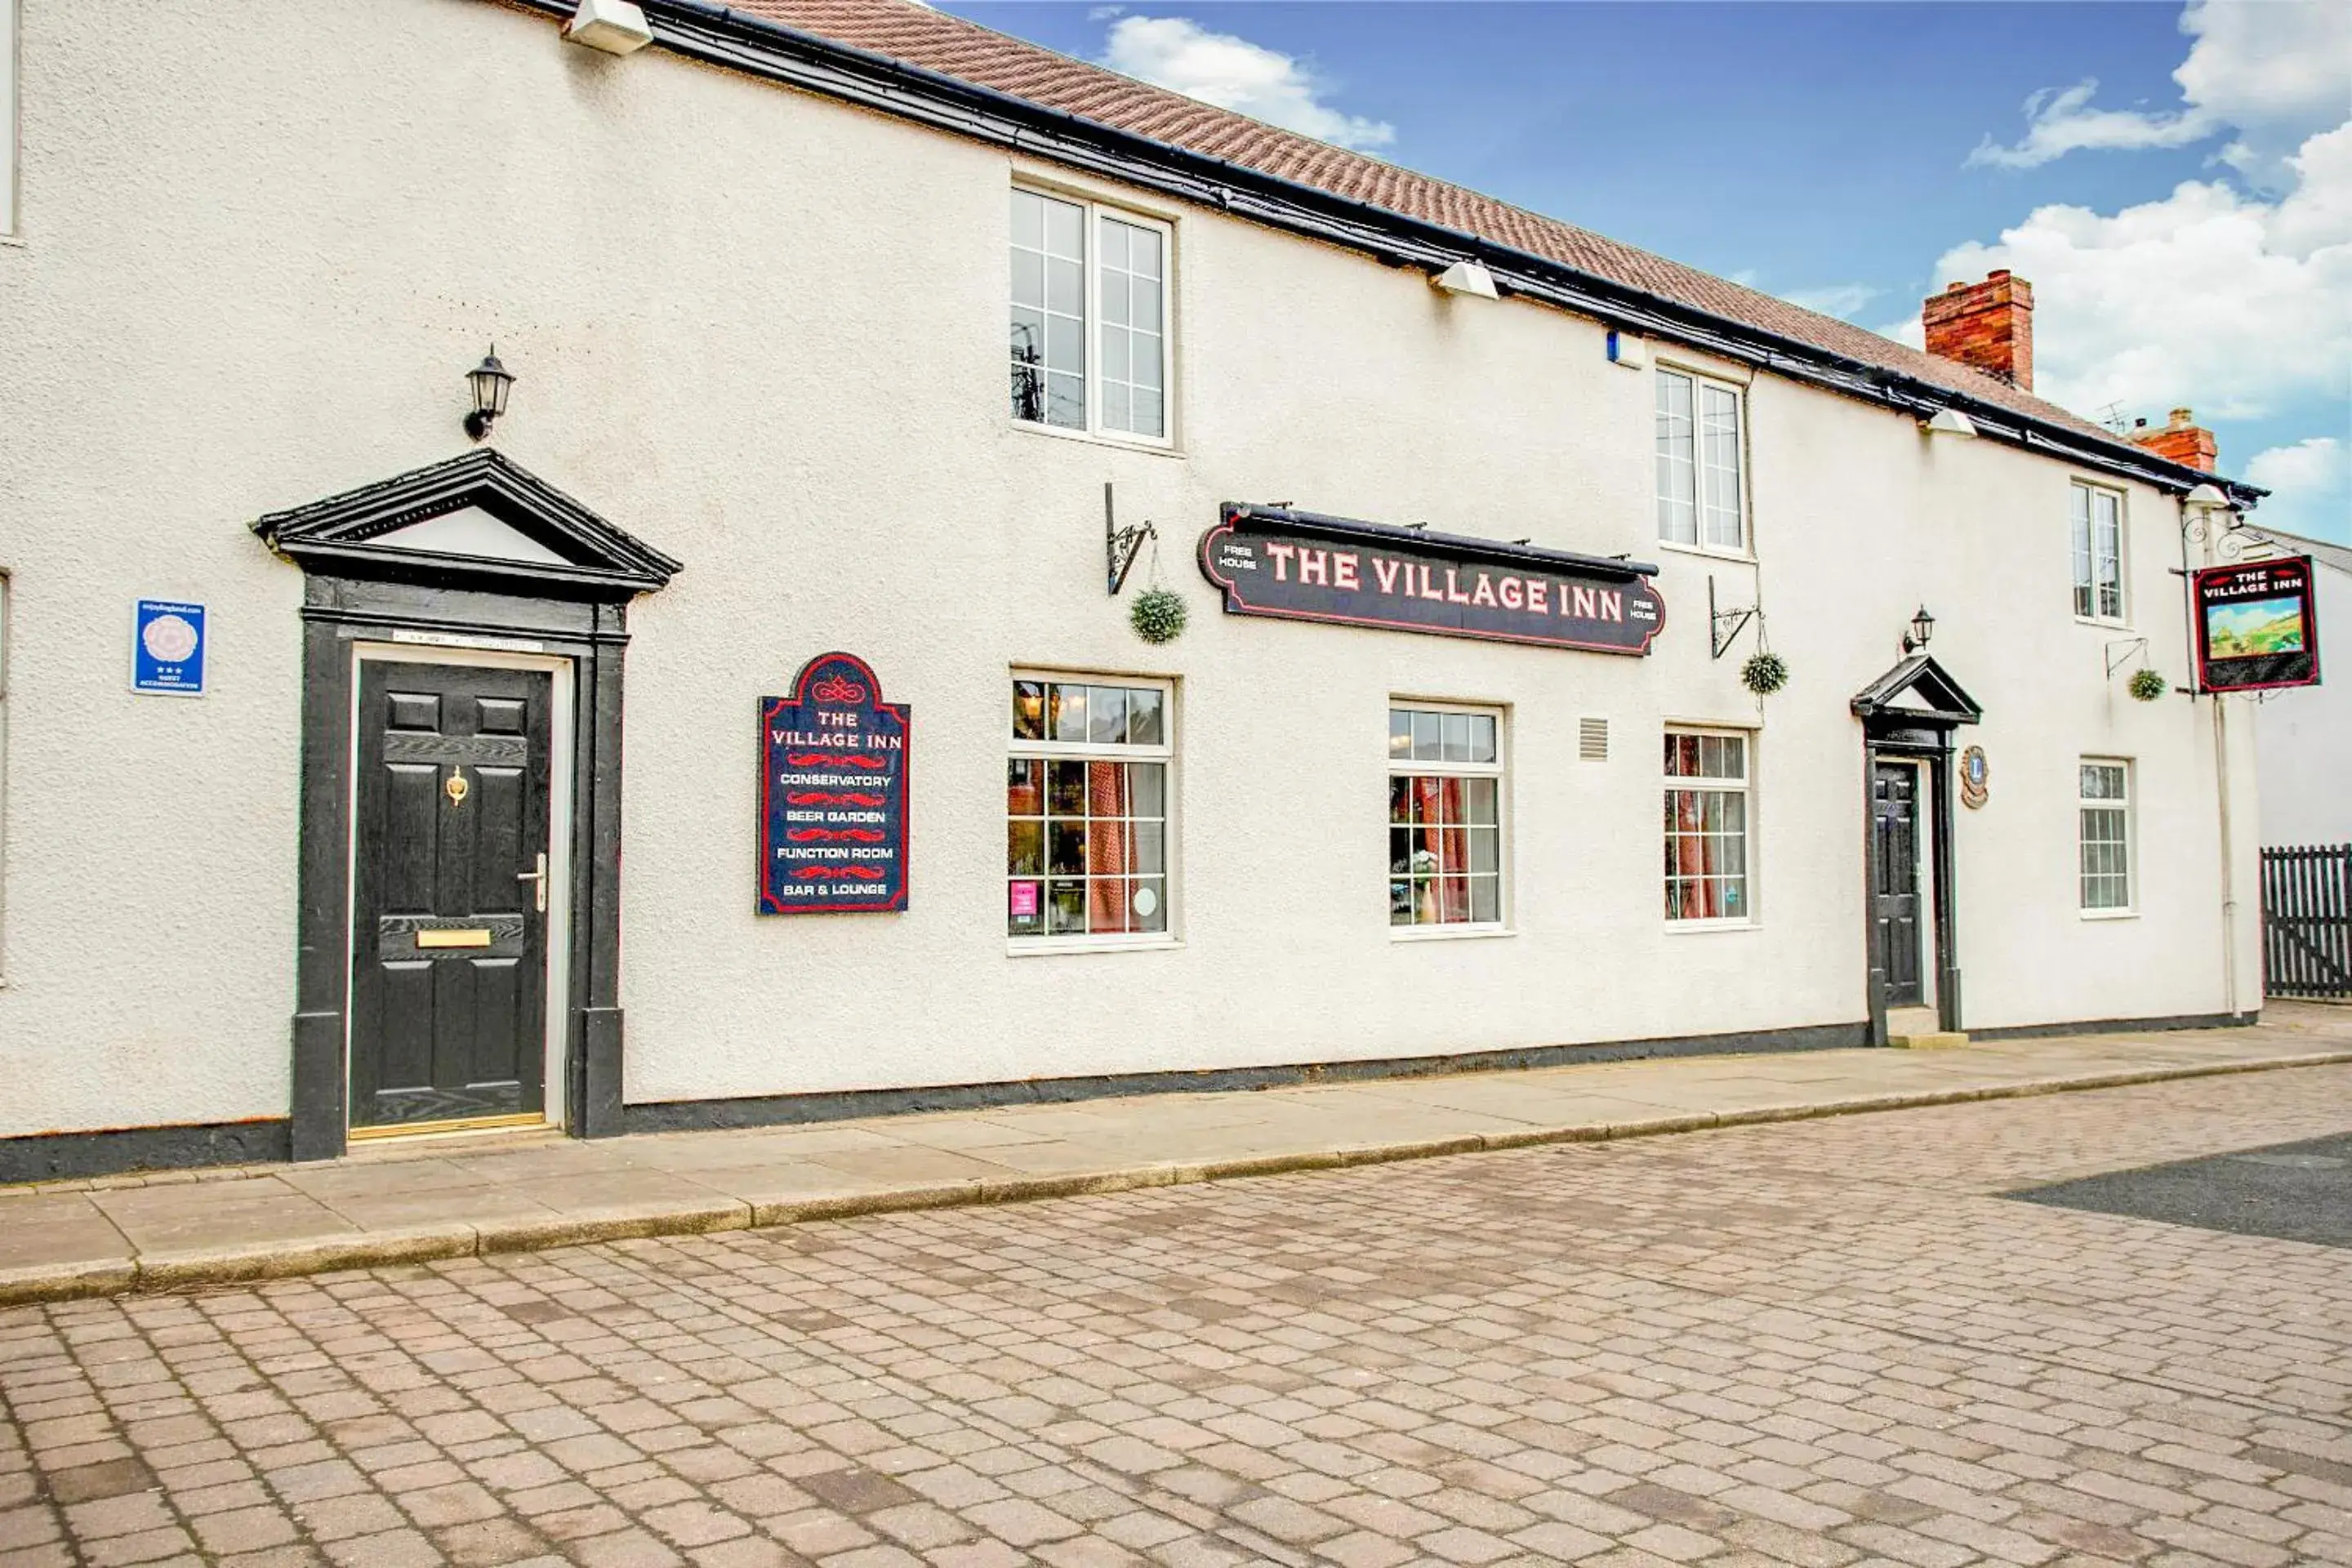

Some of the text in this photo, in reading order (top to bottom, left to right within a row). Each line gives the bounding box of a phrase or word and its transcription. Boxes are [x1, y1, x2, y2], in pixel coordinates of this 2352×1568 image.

[1224, 545, 1252, 556] FREE
[1219, 557, 1257, 569] HOUSE
[1267, 542, 1622, 621] THE VILLAGE INN
[2236, 571, 2267, 582] THE
[2205, 578, 2302, 598] VILLAGE INN
[818, 711, 857, 727] THE
[773, 730, 902, 749] VILLAGE INN
[780, 774, 891, 786] CONSERVATORY
[786, 811, 885, 822] BEER GARDEN
[777, 848, 893, 858] FUNCTION ROOM
[783, 884, 887, 896] BAR & LOUNGE
